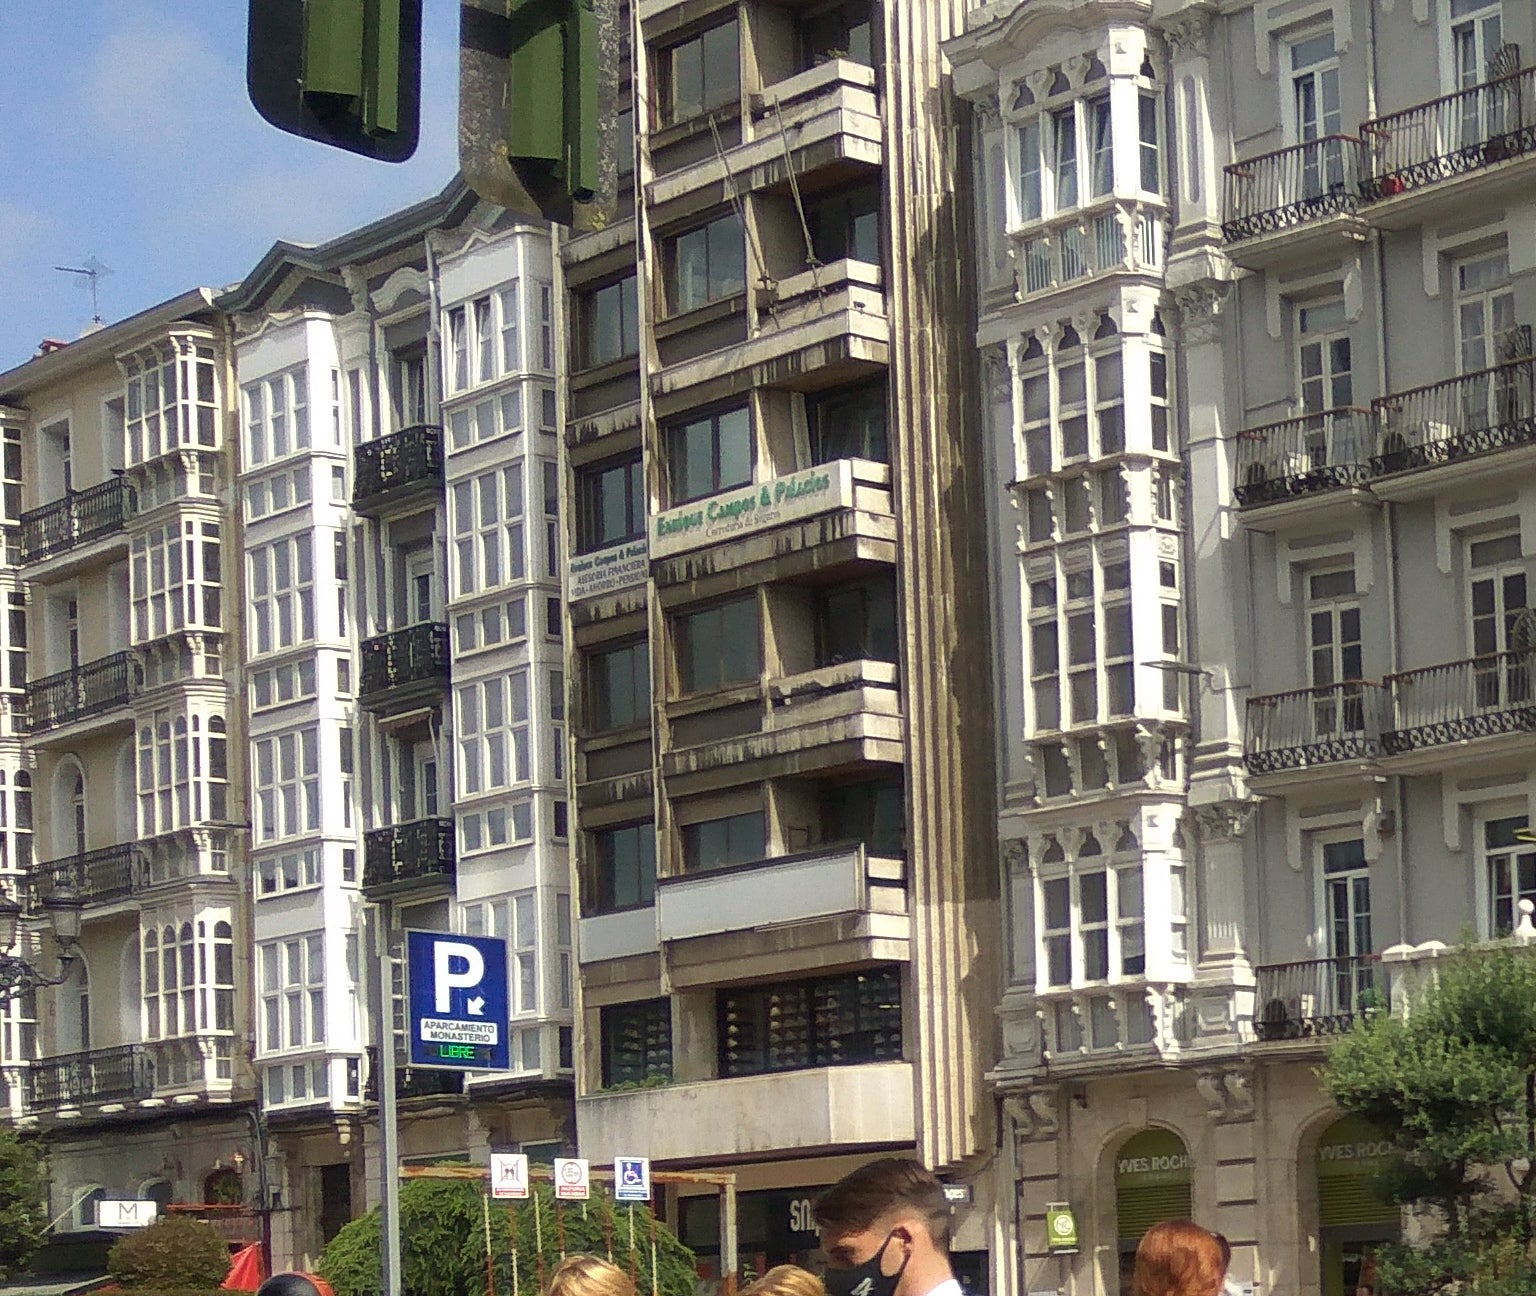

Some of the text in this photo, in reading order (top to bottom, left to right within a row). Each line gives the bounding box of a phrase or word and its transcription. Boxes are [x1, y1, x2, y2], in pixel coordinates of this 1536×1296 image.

[434, 941, 484, 1013] P
[424, 1021, 495, 1034] APARCAMIENTO
[430, 1031, 490, 1043] MONASTERIO
[440, 1045, 475, 1059] LIBRE
[1320, 1144, 1353, 1160] YVES
[1119, 1155, 1189, 1174] YVES ROCH
